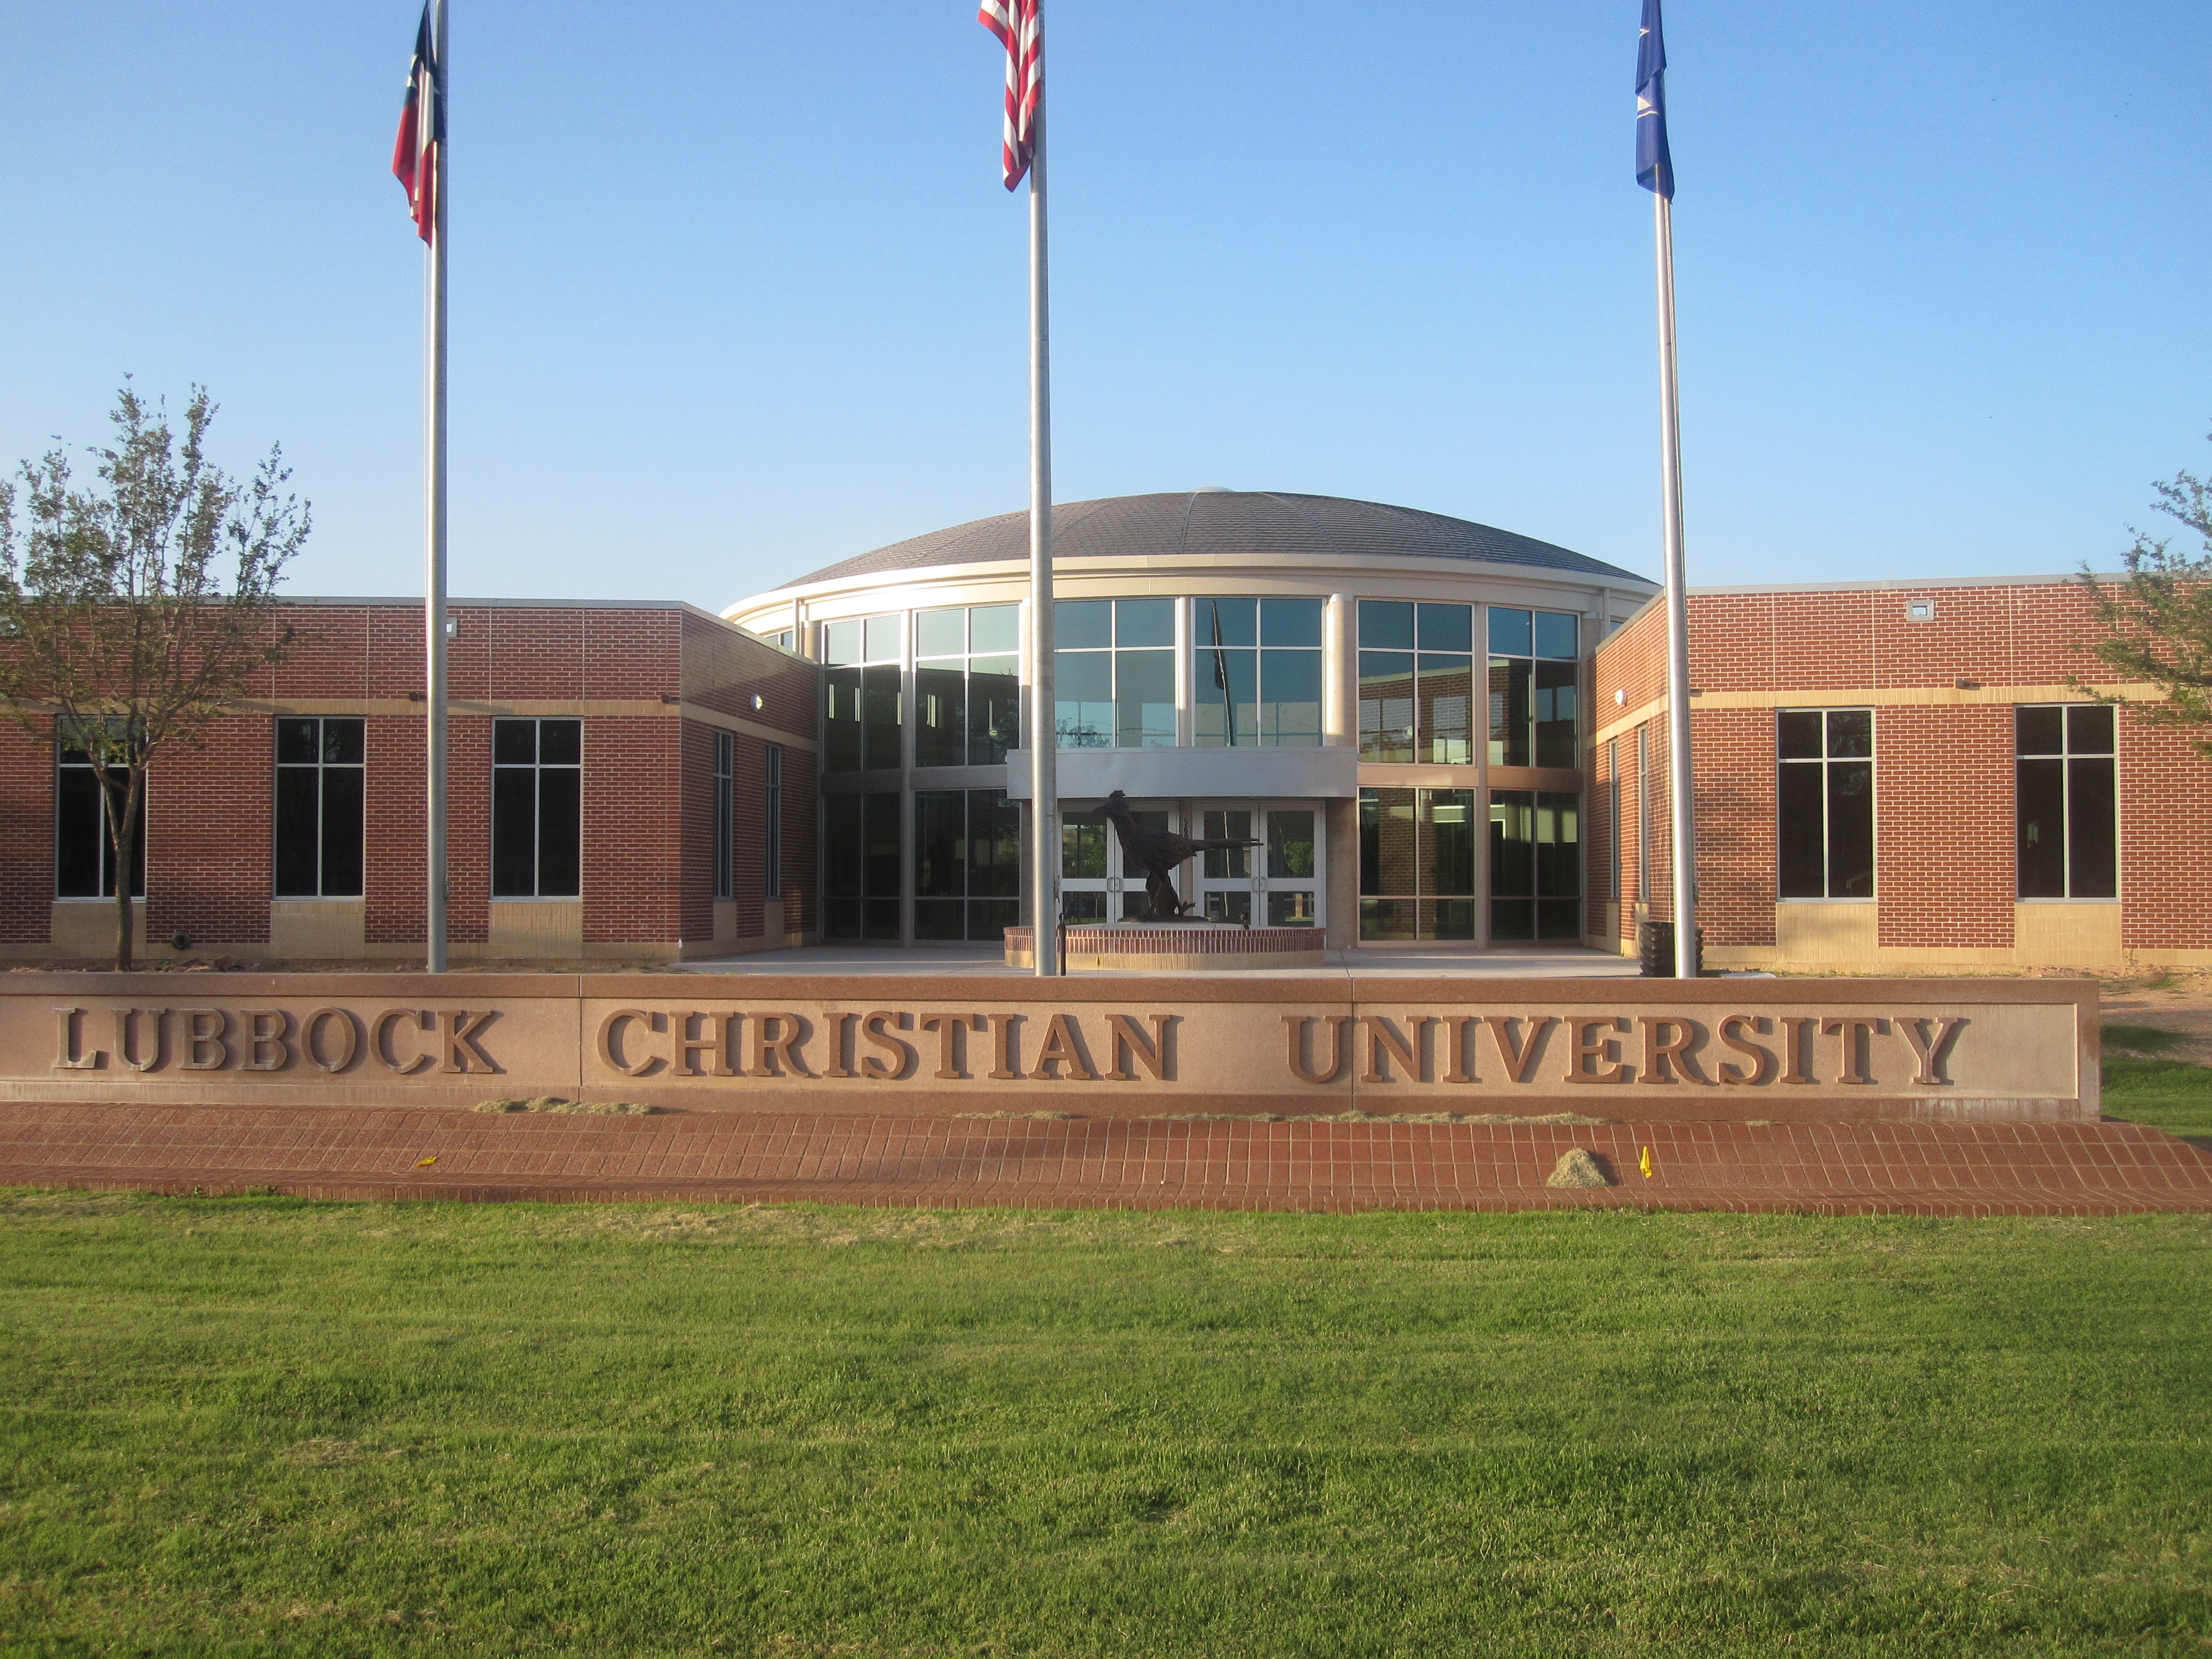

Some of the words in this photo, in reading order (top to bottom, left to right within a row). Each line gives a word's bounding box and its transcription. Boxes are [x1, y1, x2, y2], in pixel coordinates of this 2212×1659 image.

[53, 1007, 494, 1073] LUBBOCK
[596, 1008, 1171, 1081] CHRISTIAN
[1281, 1014, 1960, 1084] UNIVERSITY
